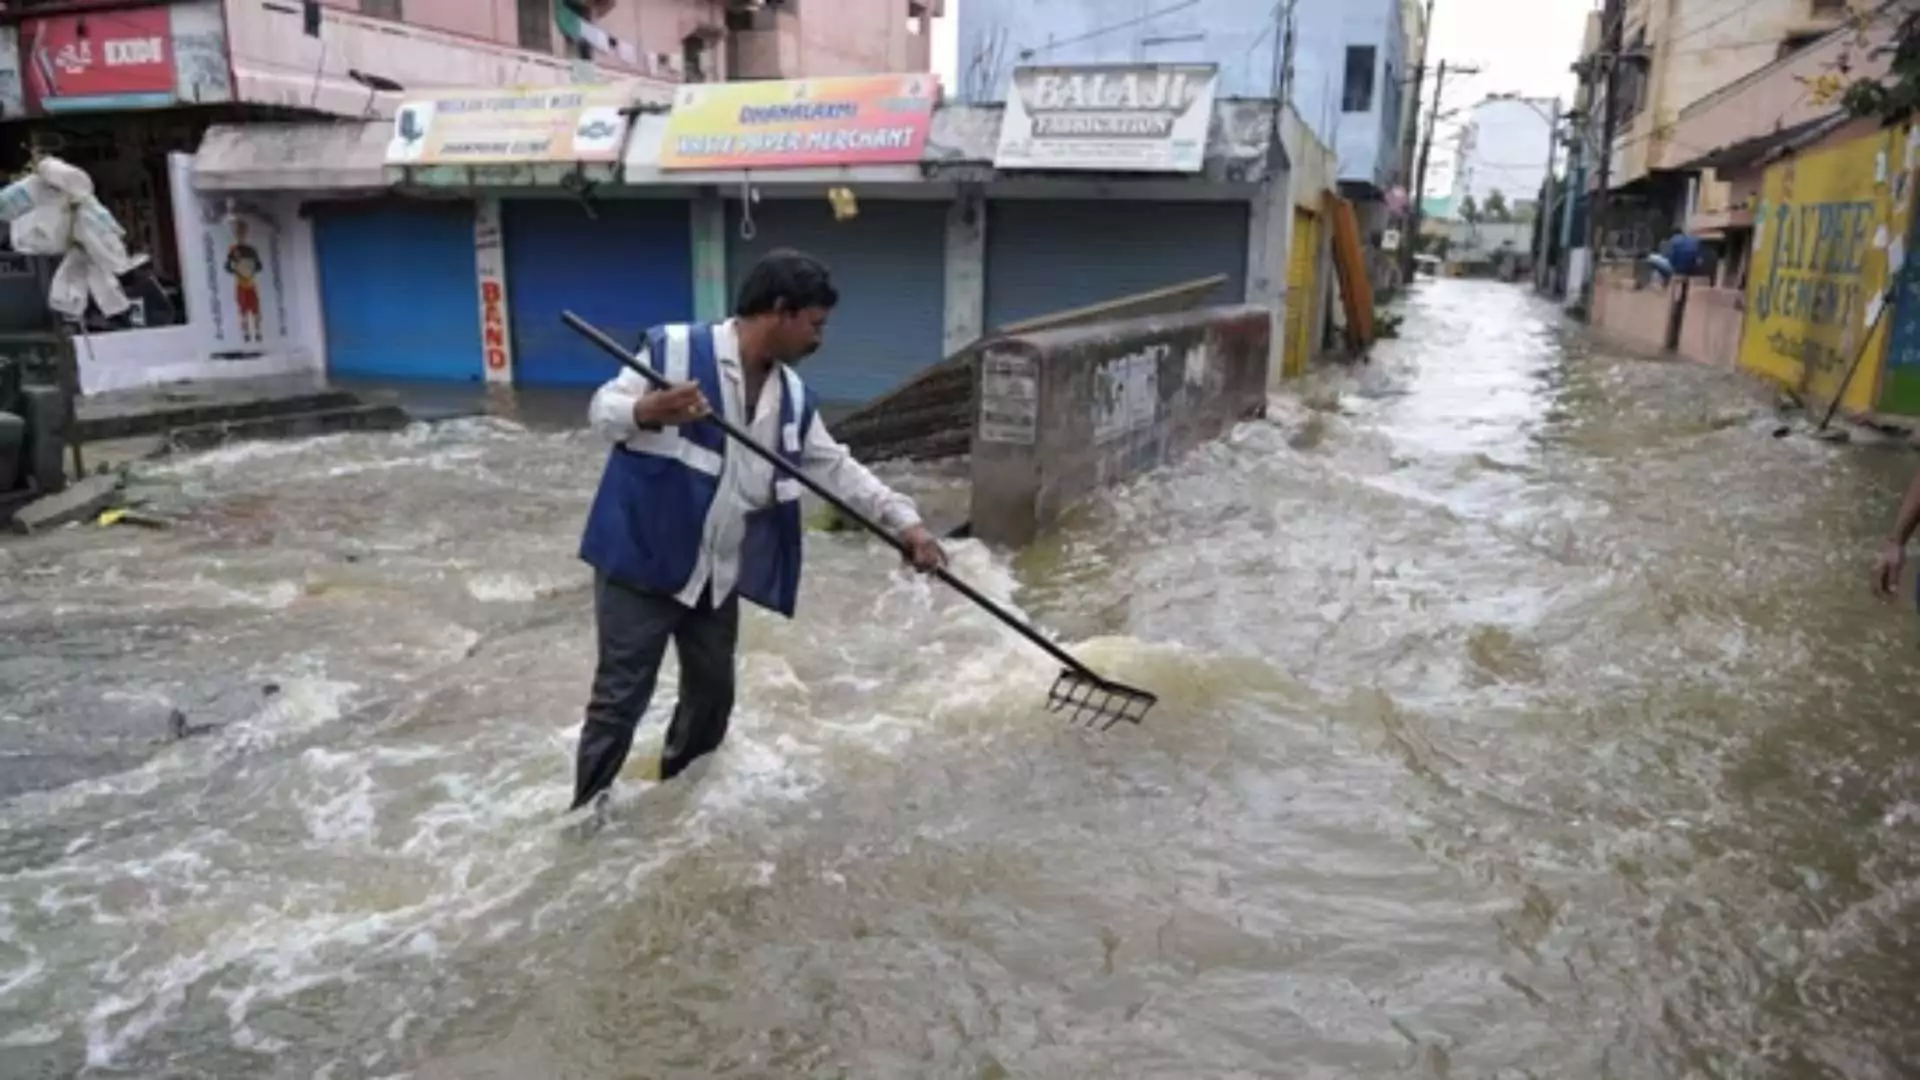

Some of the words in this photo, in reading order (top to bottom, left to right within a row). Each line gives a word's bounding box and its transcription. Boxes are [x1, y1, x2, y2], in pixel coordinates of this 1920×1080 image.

[104, 37, 163, 66] EXIDE
[1033, 72, 1188, 108] BALAJI
[738, 102, 859, 124] DHANALAXMI
[1037, 115, 1169, 134] FABRICATION
[808, 126, 916, 150] MERCHANT
[1756, 201, 1874, 322] JAYPEE
[1774, 276, 1862, 326] CEMENT
[481, 280, 506, 370] BAND
